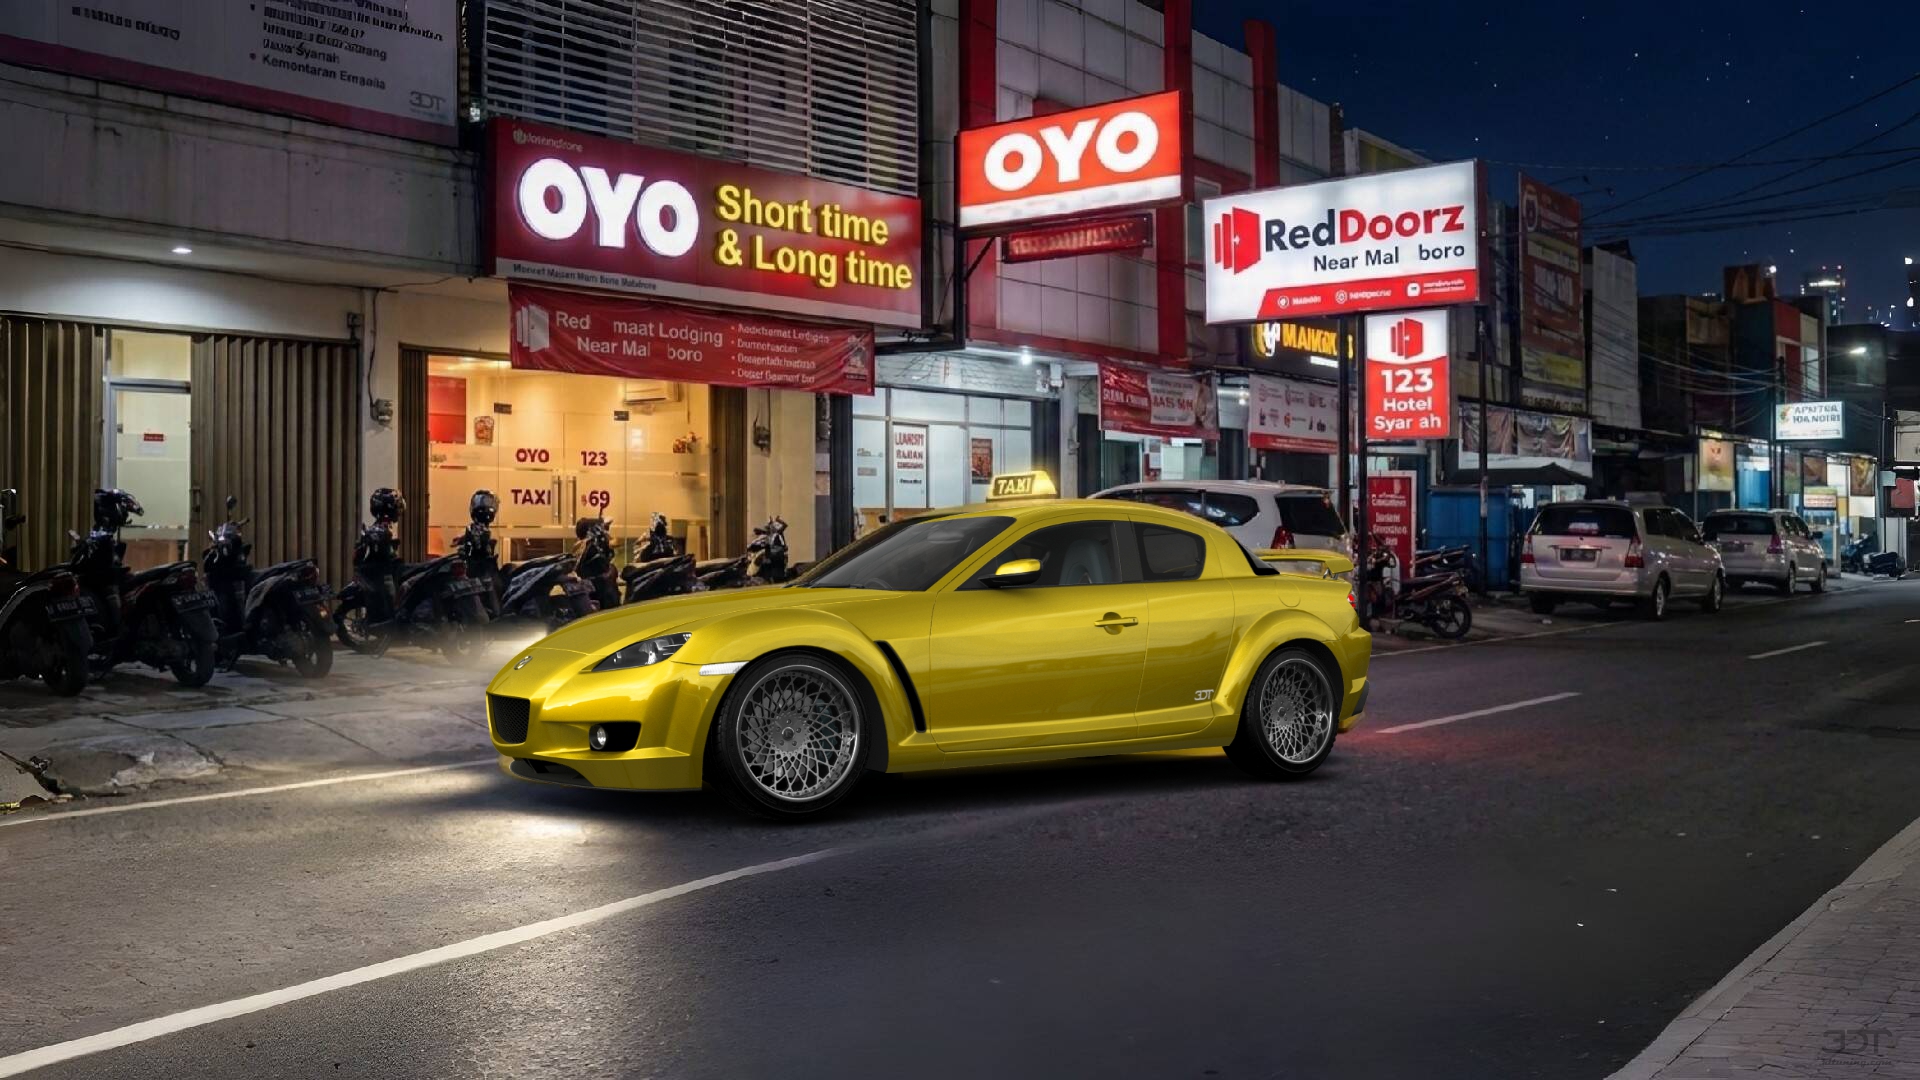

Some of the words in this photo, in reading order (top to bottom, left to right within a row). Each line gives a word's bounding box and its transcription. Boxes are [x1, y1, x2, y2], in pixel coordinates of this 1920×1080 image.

[984, 112, 1159, 191] OYO
[519, 158, 699, 257] OYO
[718, 184, 813, 233] Short
[821, 204, 889, 245] time
[1265, 205, 1465, 252] RedDoorz
[718, 229, 743, 265] &
[755, 235, 837, 288] Long
[845, 250, 913, 289] time
[1314, 254, 1359, 272] Near
[1365, 246, 1399, 266] Mal
[1418, 244, 1465, 261] boro
[556, 311, 591, 330] Red
[613, 320, 654, 338] maat
[658, 322, 724, 348] Lodging
[577, 336, 617, 354] Near
[667, 344, 703, 362] boro
[1381, 367, 1433, 393] 123
[1383, 397, 1433, 412] Hotel
[1374, 416, 1413, 433] Syar
[1419, 413, 1442, 428] ah
[516, 448, 550, 463] OYO
[580, 450, 608, 466] 123
[511, 489, 551, 505] TAXI
[588, 490, 610, 508] 69
[997, 477, 1032, 494] TAXI
[1194, 689, 1215, 701] 3DT
